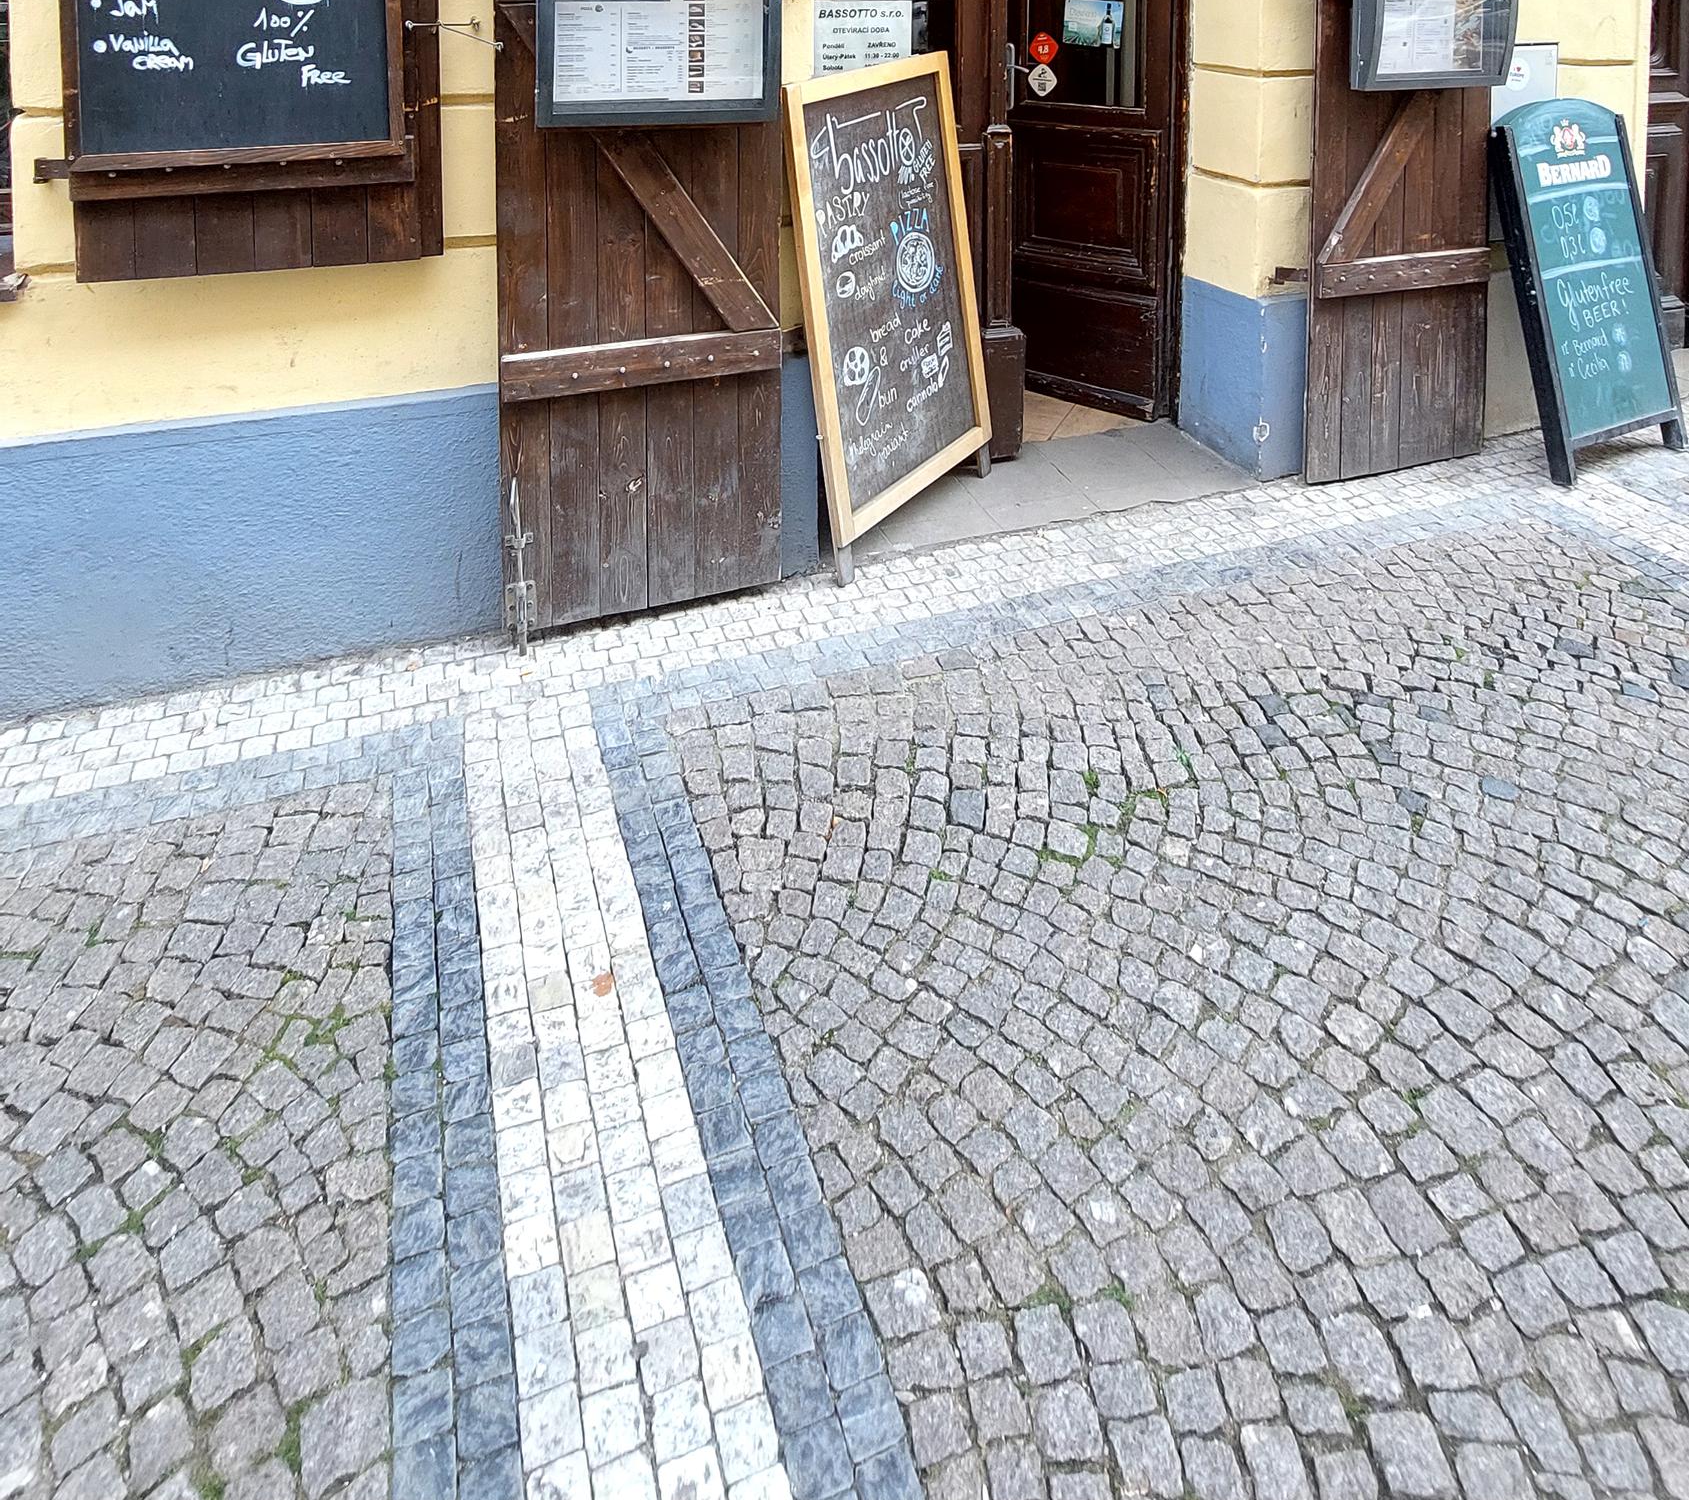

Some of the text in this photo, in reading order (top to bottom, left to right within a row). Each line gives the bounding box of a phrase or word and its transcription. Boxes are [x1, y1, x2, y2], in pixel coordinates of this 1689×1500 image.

[818, 9, 878, 19] BASSOTTO
[1536, 154, 1612, 188] BERNARD
[816, 192, 870, 238] PASTRY
[890, 208, 930, 246] PIZZA
[848, 228, 886, 265] croissant
[930, 264, 944, 294] dark
[870, 312, 902, 343] bread
[1582, 300, 1630, 328] BEER!
[880, 346, 889, 366] &
[878, 387, 898, 410] bun
